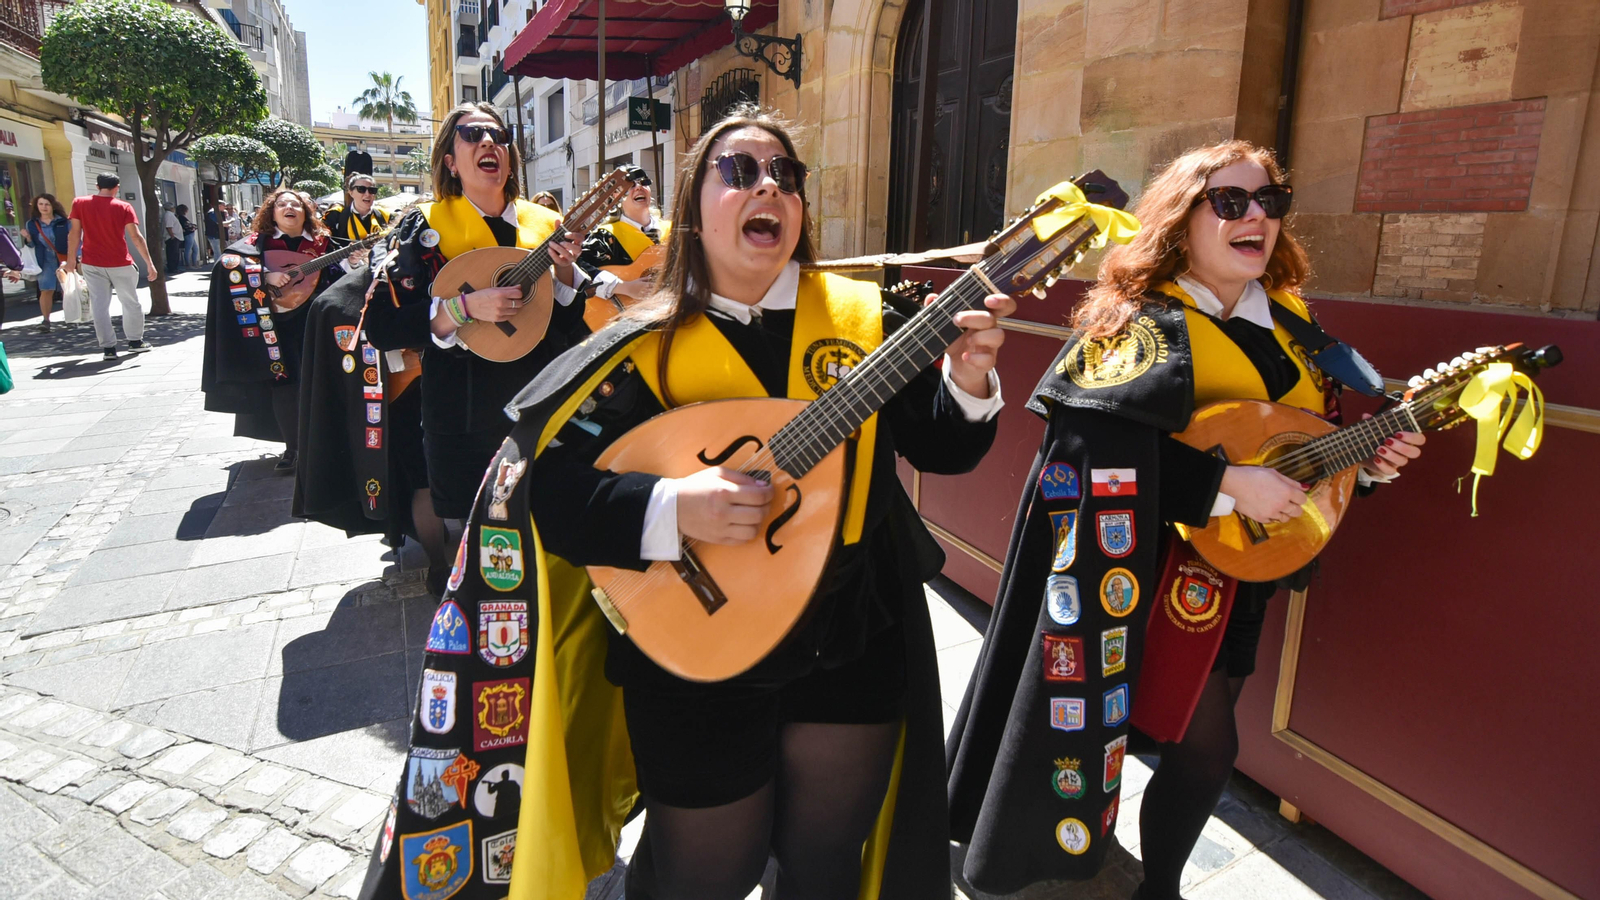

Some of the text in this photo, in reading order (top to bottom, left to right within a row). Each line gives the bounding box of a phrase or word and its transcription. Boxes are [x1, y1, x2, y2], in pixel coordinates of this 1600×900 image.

[1138, 316, 1169, 364] GRANADA
[808, 340, 824, 355] TUNA
[481, 603, 526, 611] GRANADA
[1196, 614, 1222, 633] CANTABRIA
[427, 673, 454, 682] GALICIA
[480, 734, 524, 748] CAZORLA
